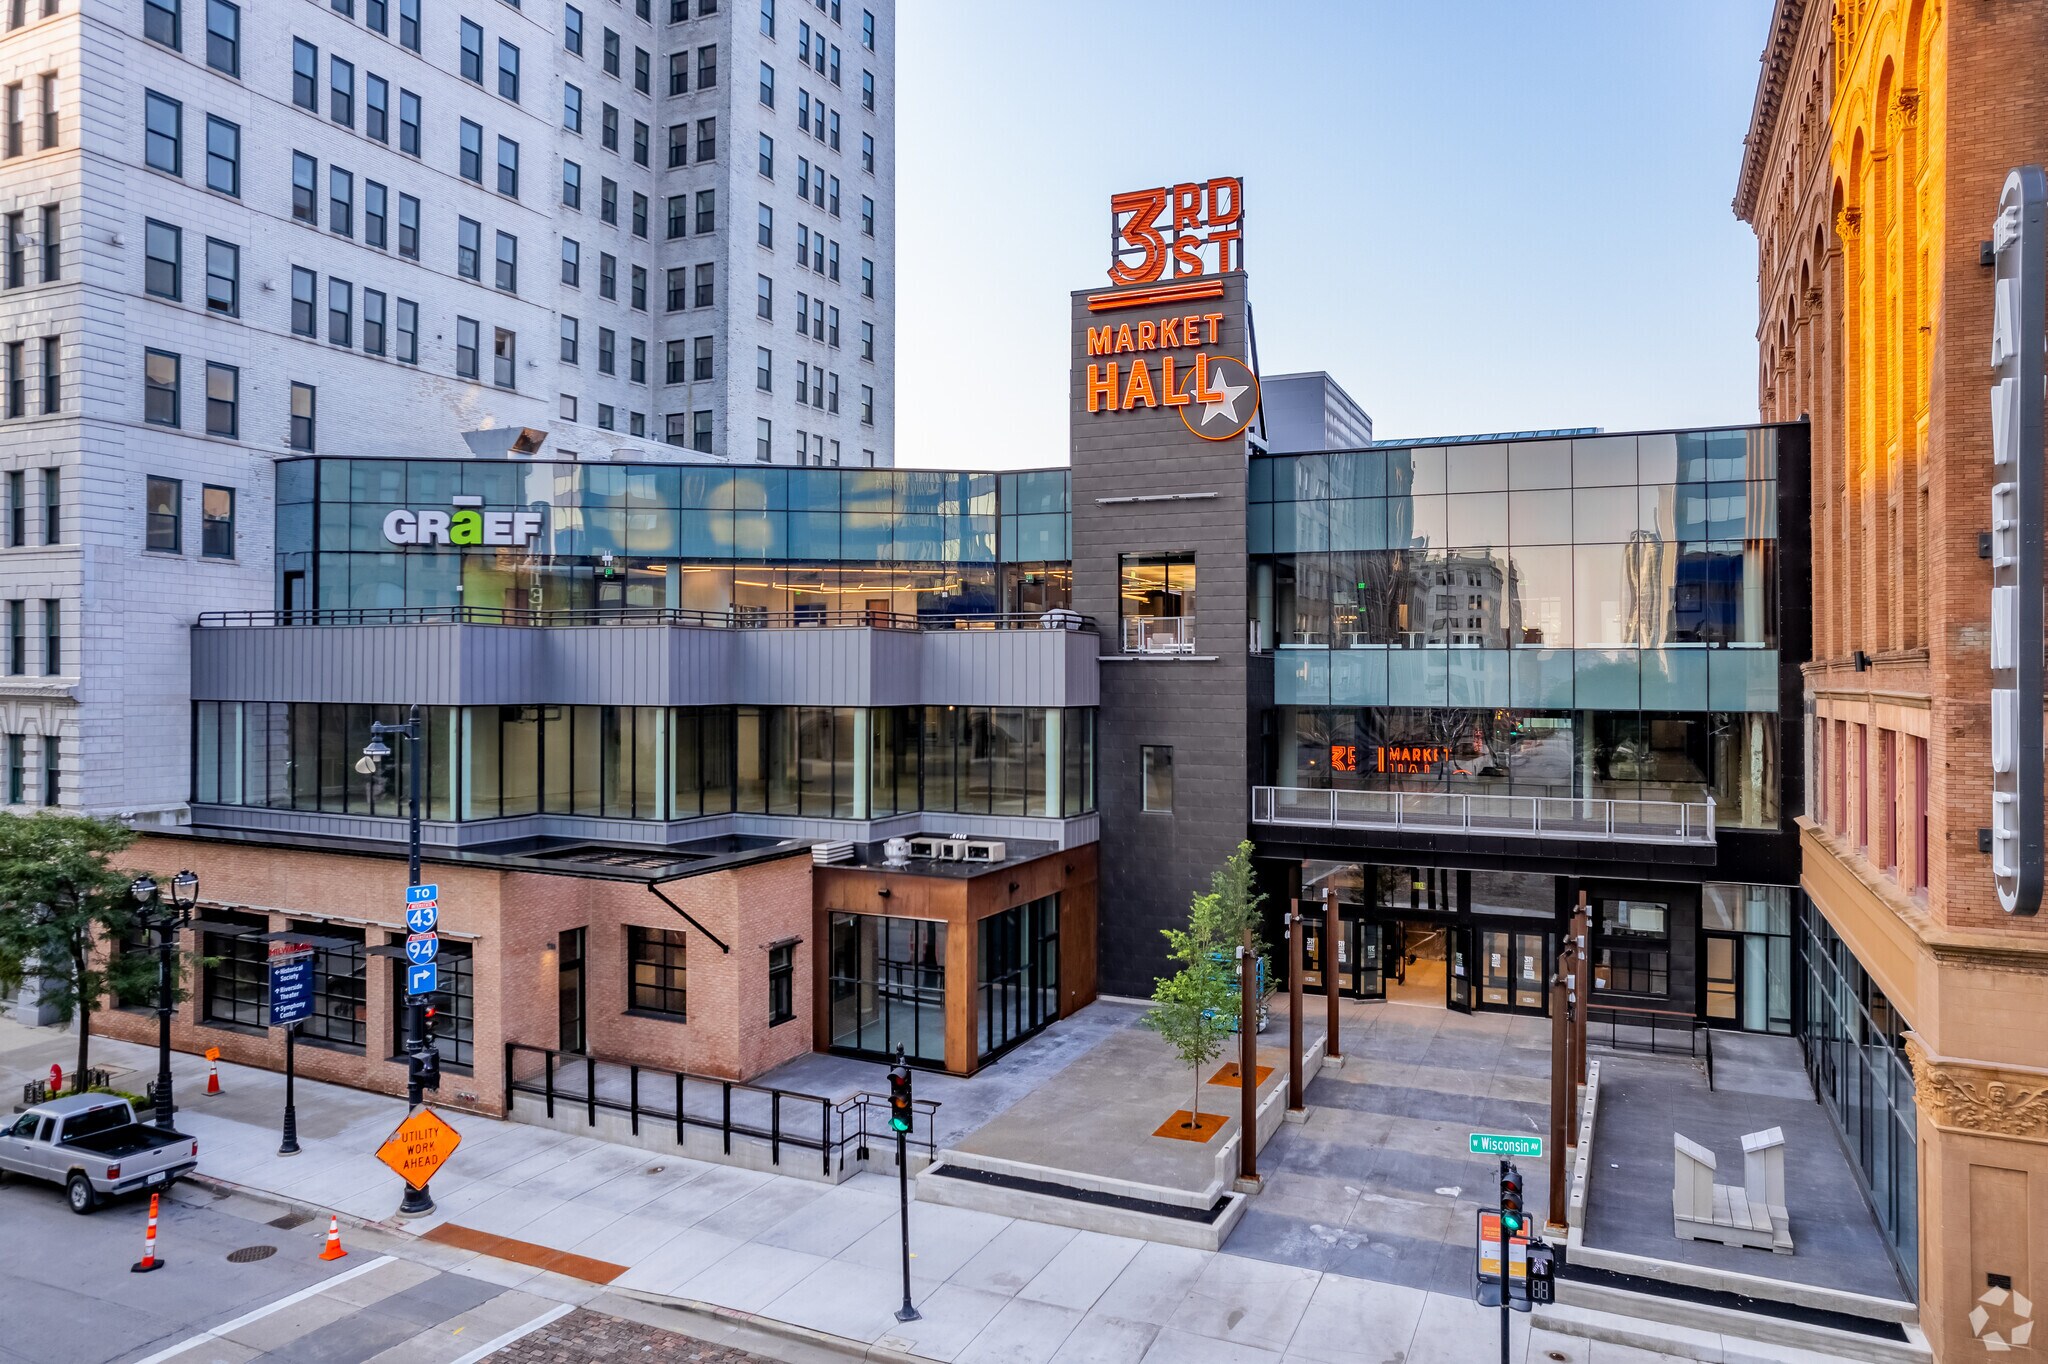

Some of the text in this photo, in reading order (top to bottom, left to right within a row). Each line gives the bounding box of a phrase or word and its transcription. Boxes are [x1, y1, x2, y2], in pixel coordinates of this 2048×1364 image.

[1172, 229, 1242, 279] ST
[1087, 312, 1224, 356] MARKET
[1087, 352, 1224, 414] HALL
[414, 888, 430, 899] TO
[409, 908, 434, 927] 43
[409, 940, 433, 959] 94
[280, 964, 303, 974] Historical
[280, 973, 299, 982] Society
[280, 983, 303, 993] Riverside
[280, 991, 299, 1000] Theater
[280, 1001, 306, 1012] Symphony
[280, 1010, 296, 1019] Center
[402, 1127, 439, 1143] UTILITY
[407, 1141, 435, 1155] WORK
[1472, 1139, 1479, 1147] W
[1481, 1137, 1529, 1153] Wisconsin
[403, 1154, 438, 1170] AHEAD
